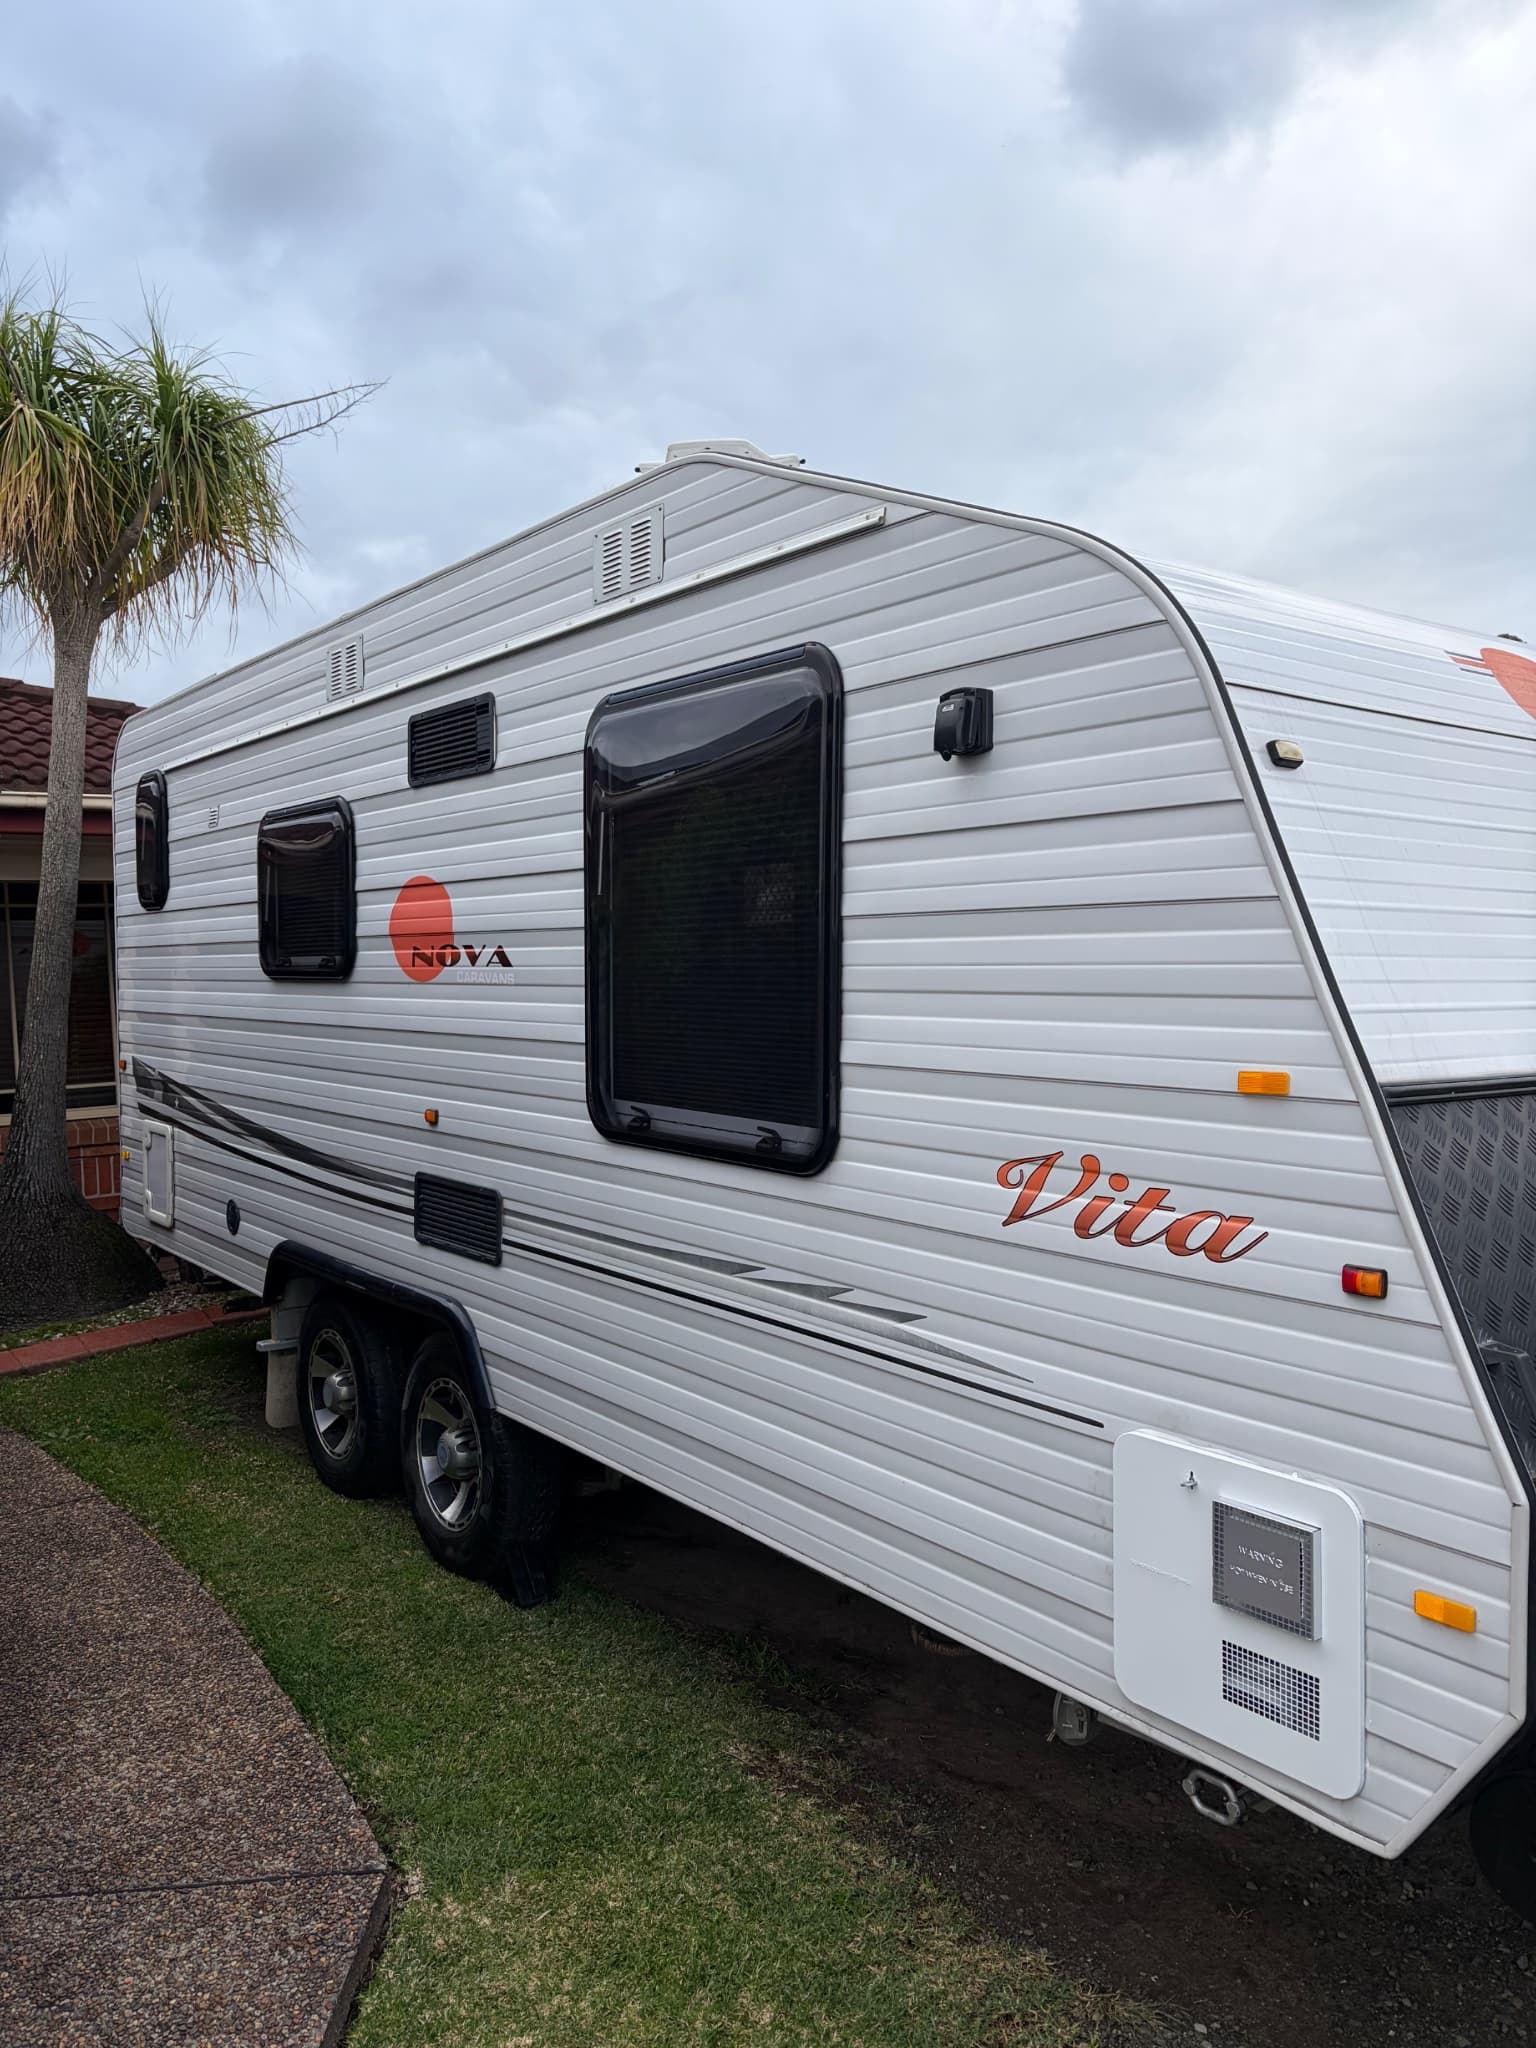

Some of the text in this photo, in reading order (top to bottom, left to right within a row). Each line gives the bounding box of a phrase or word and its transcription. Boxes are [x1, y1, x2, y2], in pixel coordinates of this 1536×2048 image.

[411, 944, 514, 967] NOVA
[456, 970, 515, 985] CARAVANS
[996, 1150, 1270, 1263] Vita
